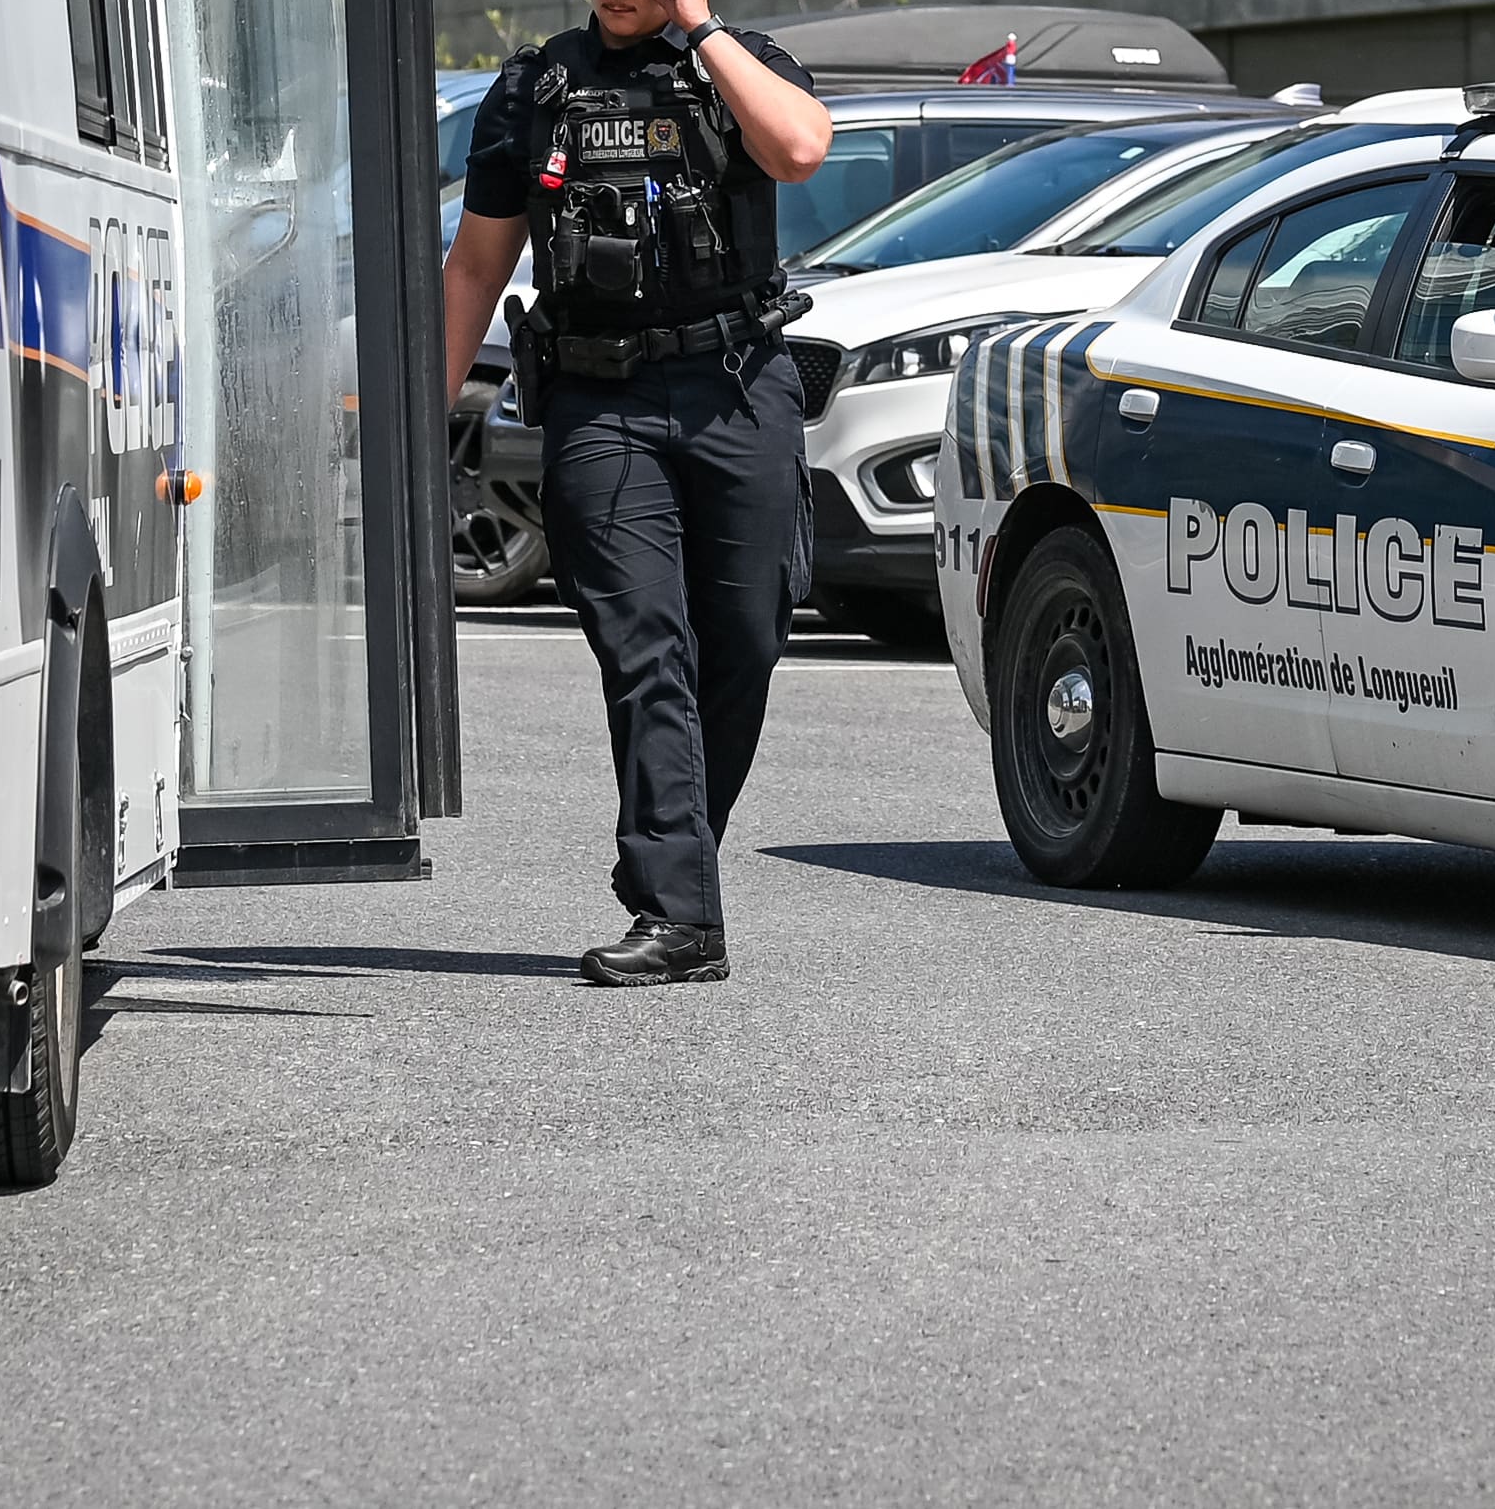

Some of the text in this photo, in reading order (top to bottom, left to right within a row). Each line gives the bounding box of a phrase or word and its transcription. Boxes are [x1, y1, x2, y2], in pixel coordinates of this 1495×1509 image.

[581, 120, 645, 148] POLICE
[84, 217, 177, 455] POLICE
[934, 521, 981, 575] 911
[1167, 496, 1487, 632] POLICE
[1185, 634, 1458, 714] Agglomération de Longueuil
